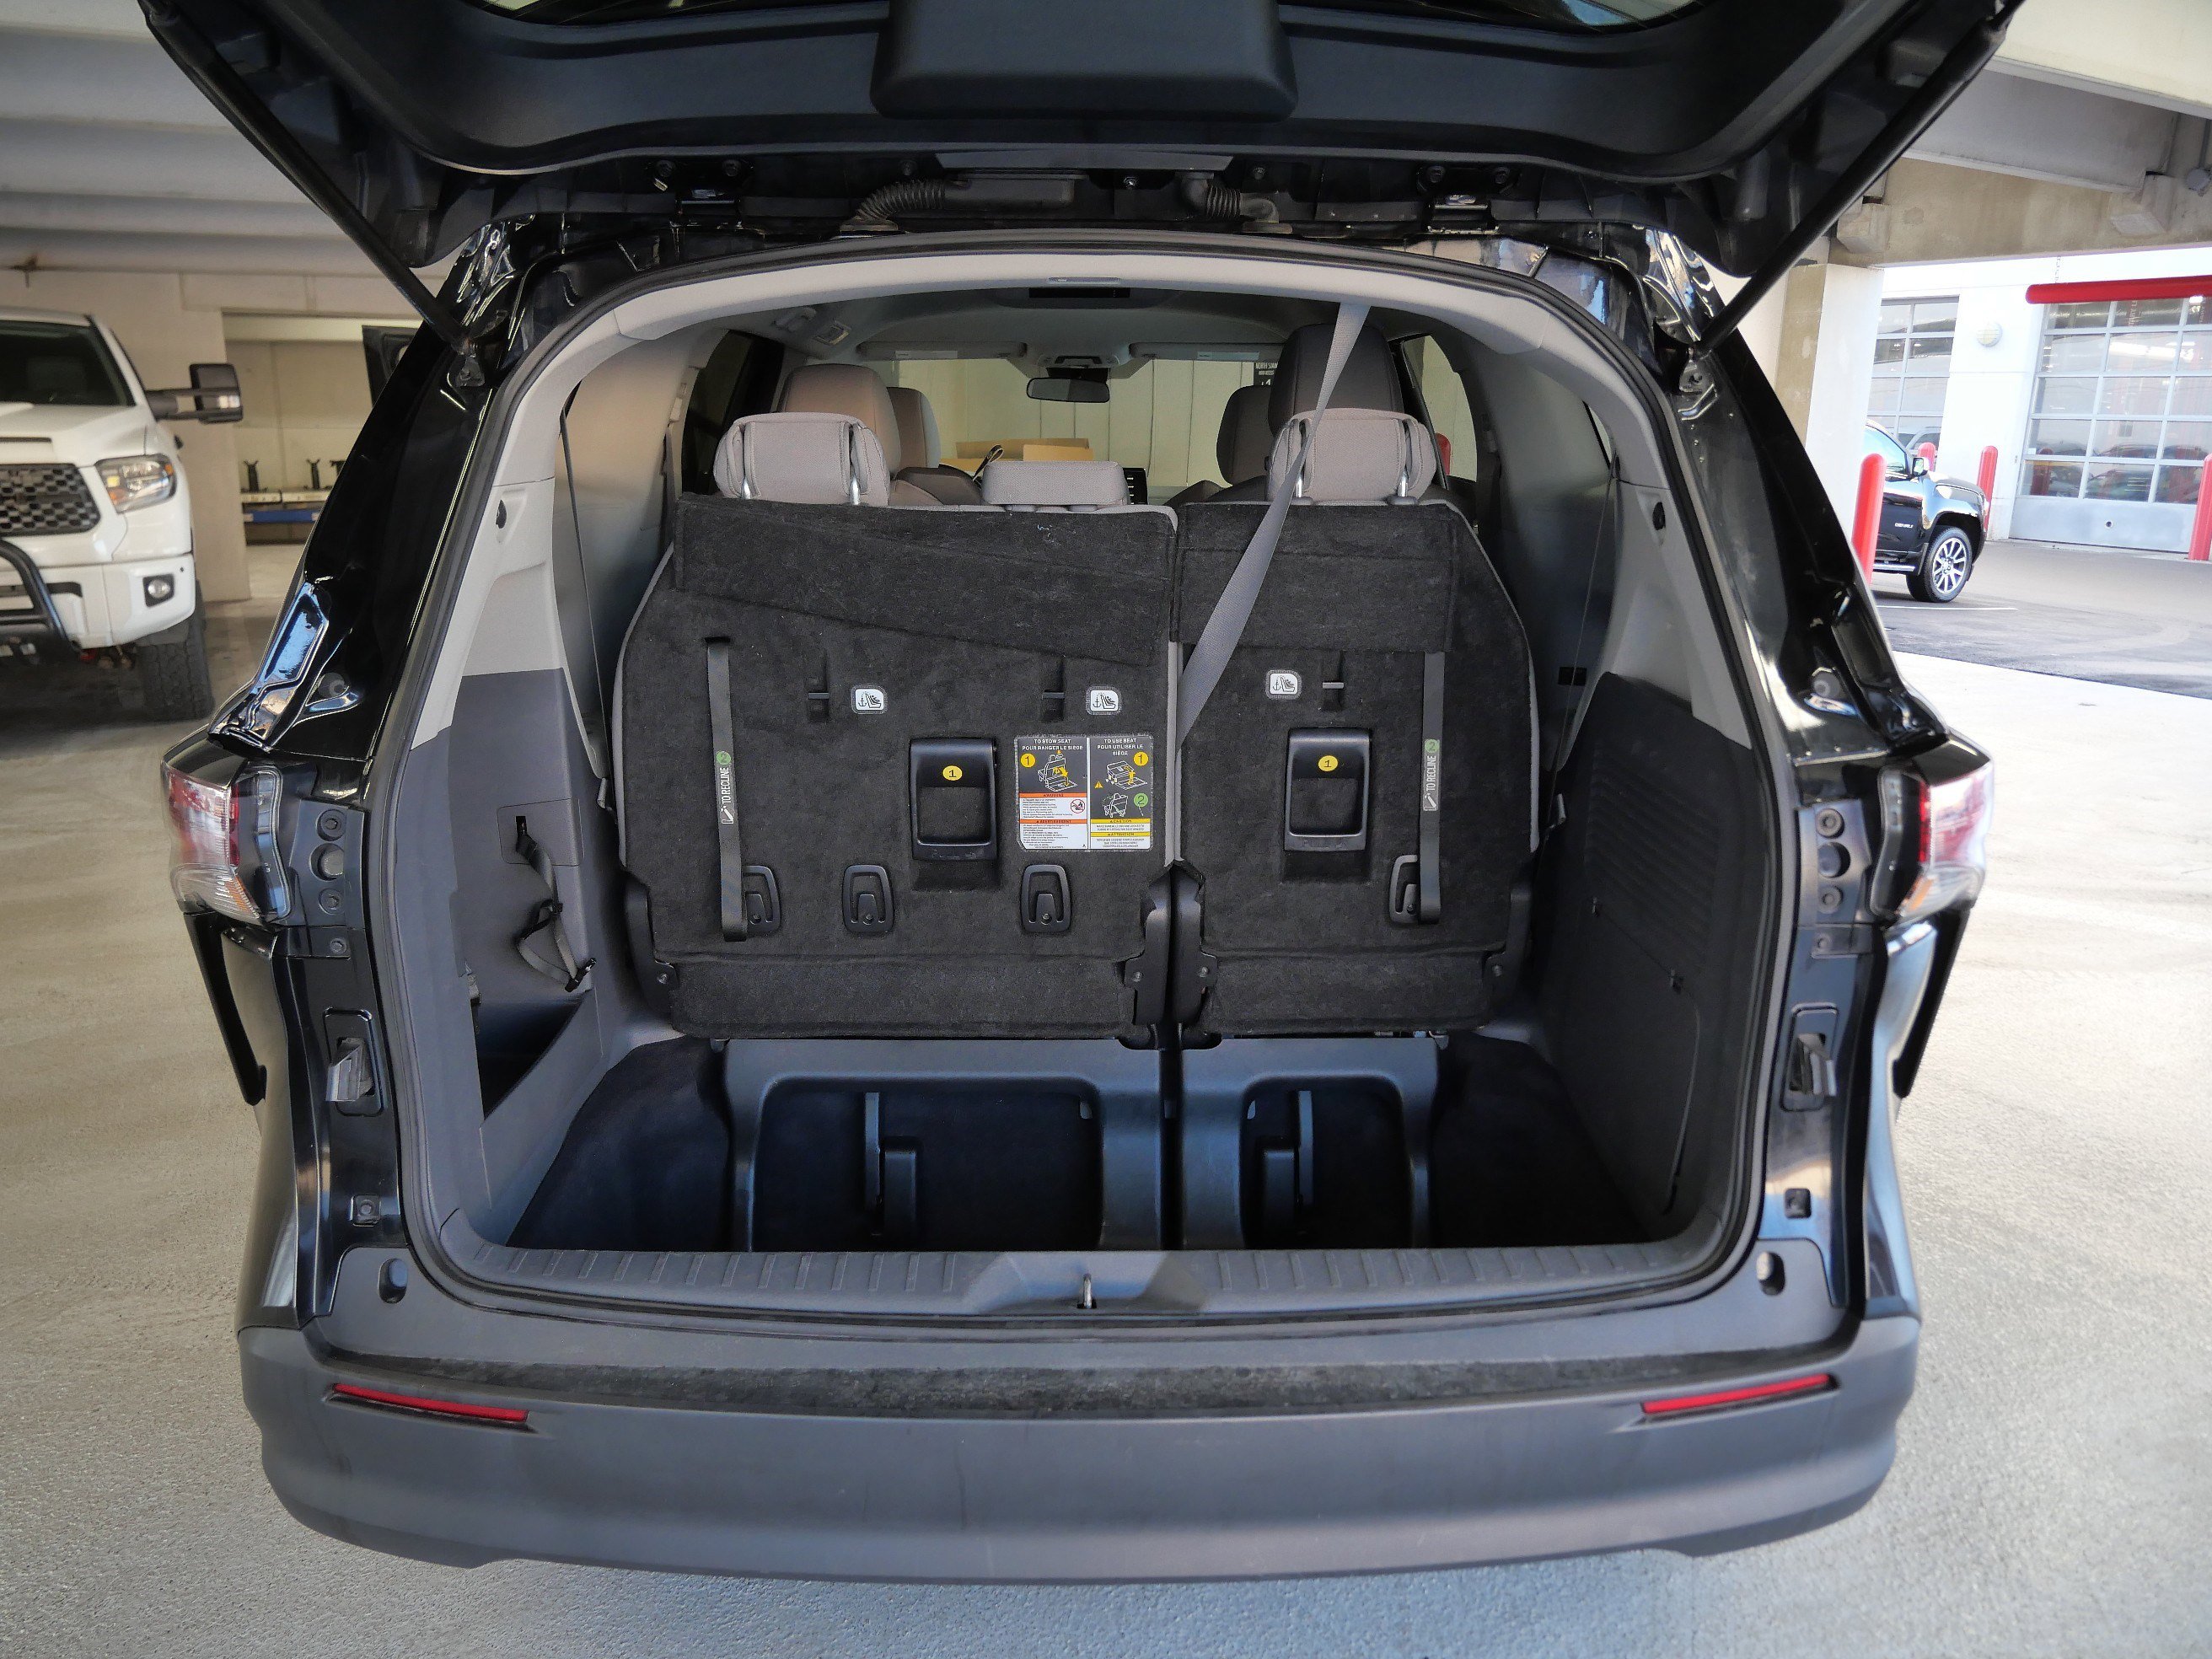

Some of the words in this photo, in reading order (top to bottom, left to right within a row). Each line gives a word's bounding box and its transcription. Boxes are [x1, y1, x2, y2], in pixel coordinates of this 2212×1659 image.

[1323, 759, 1332, 768] 1
[1426, 755, 1436, 782] RECLINE
[948, 769, 957, 778] 1
[719, 767, 731, 795] RECLINE
[1425, 782, 1436, 792] TO
[721, 795, 732, 805] TO
[1138, 795, 1145, 805] 2
